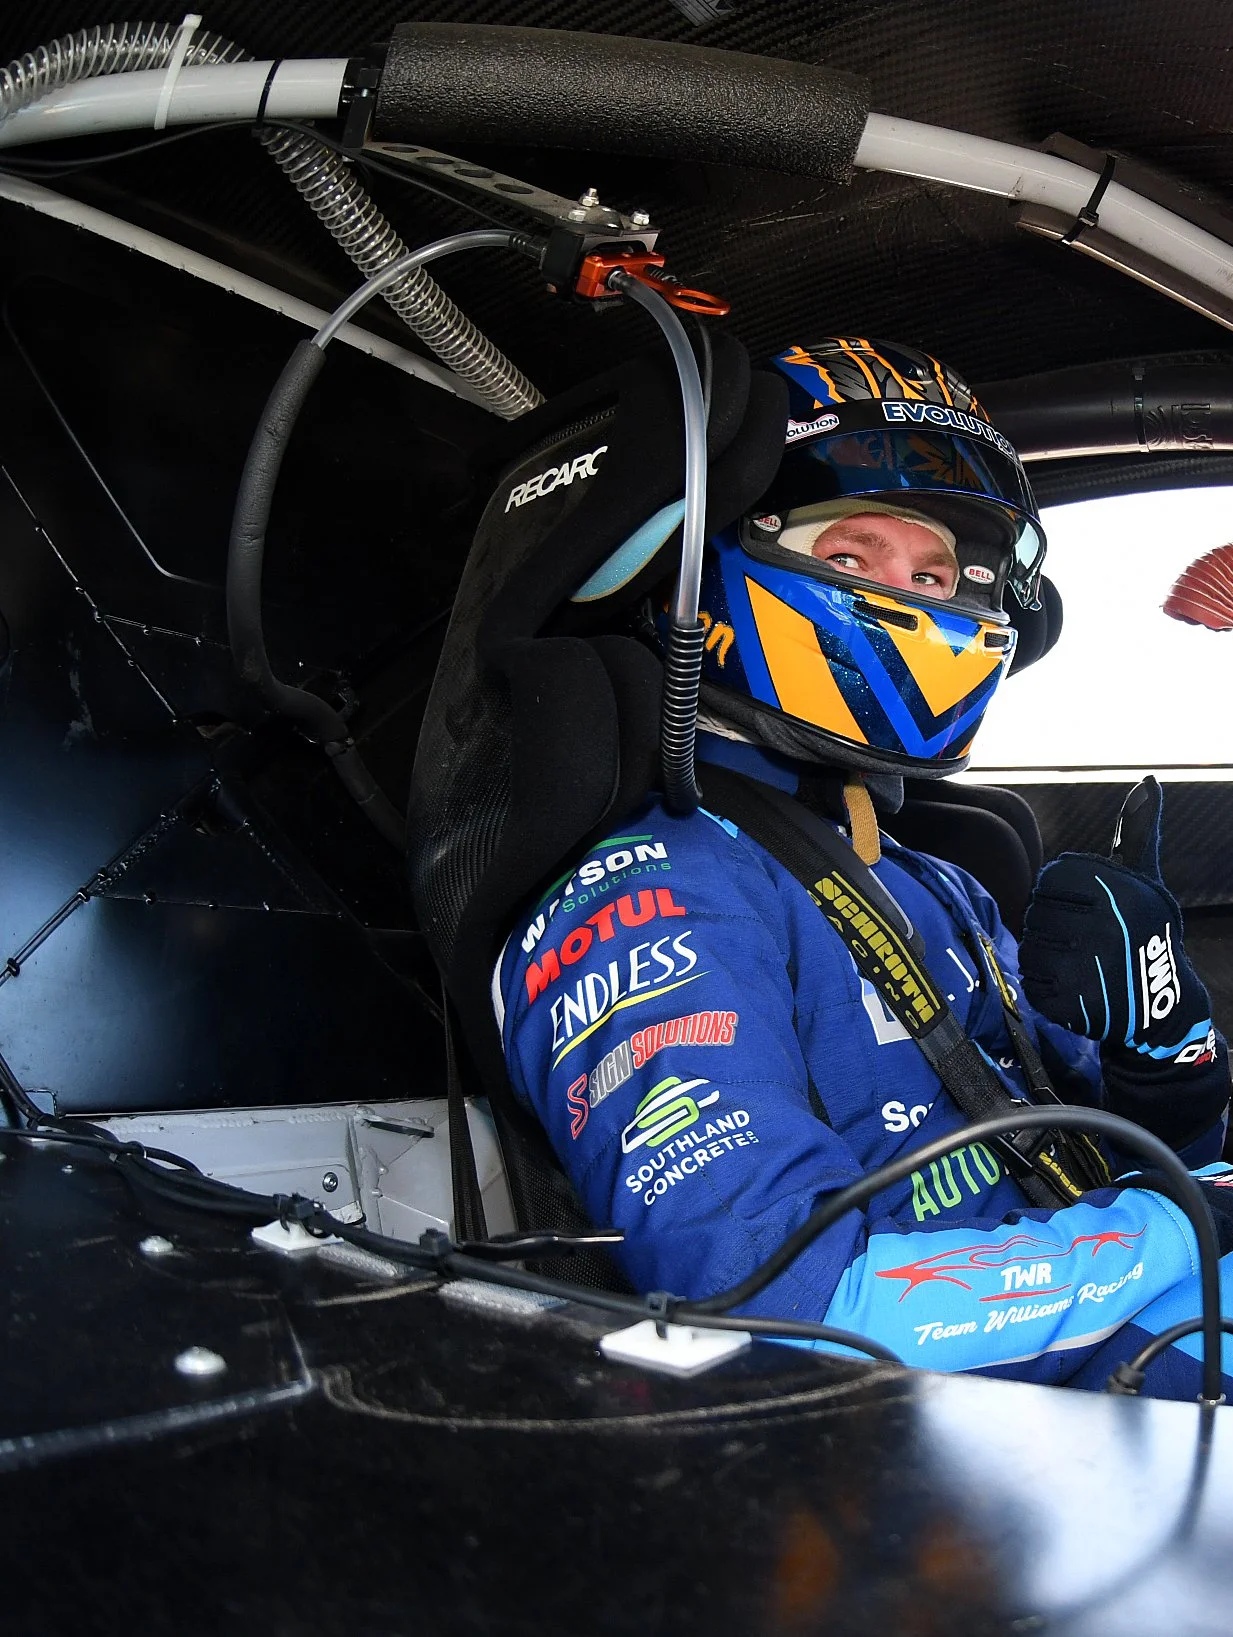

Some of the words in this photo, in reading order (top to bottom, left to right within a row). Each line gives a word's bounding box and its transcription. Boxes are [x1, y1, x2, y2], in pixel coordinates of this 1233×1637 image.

[882, 402, 1016, 457] EVOLUTIO
[969, 568, 993, 581] BELL
[562, 862, 672, 913] Solutions
[525, 888, 687, 1006] MOTUL
[815, 877, 935, 1024] SCHROTH
[1146, 934, 1176, 1020] OMP
[550, 930, 698, 1051] ENDLESS
[588, 1040, 634, 1109] SIGN
[630, 1011, 739, 1070] SOLUTIONS
[625, 1110, 751, 1194] SOUTHLAND
[644, 1132, 747, 1206] CONCRETE
[914, 1322, 977, 1345] Team
[983, 1296, 1075, 1333] Williams
[1078, 1261, 1145, 1303] Racing
[1001, 1262, 1052, 1291] TWR
